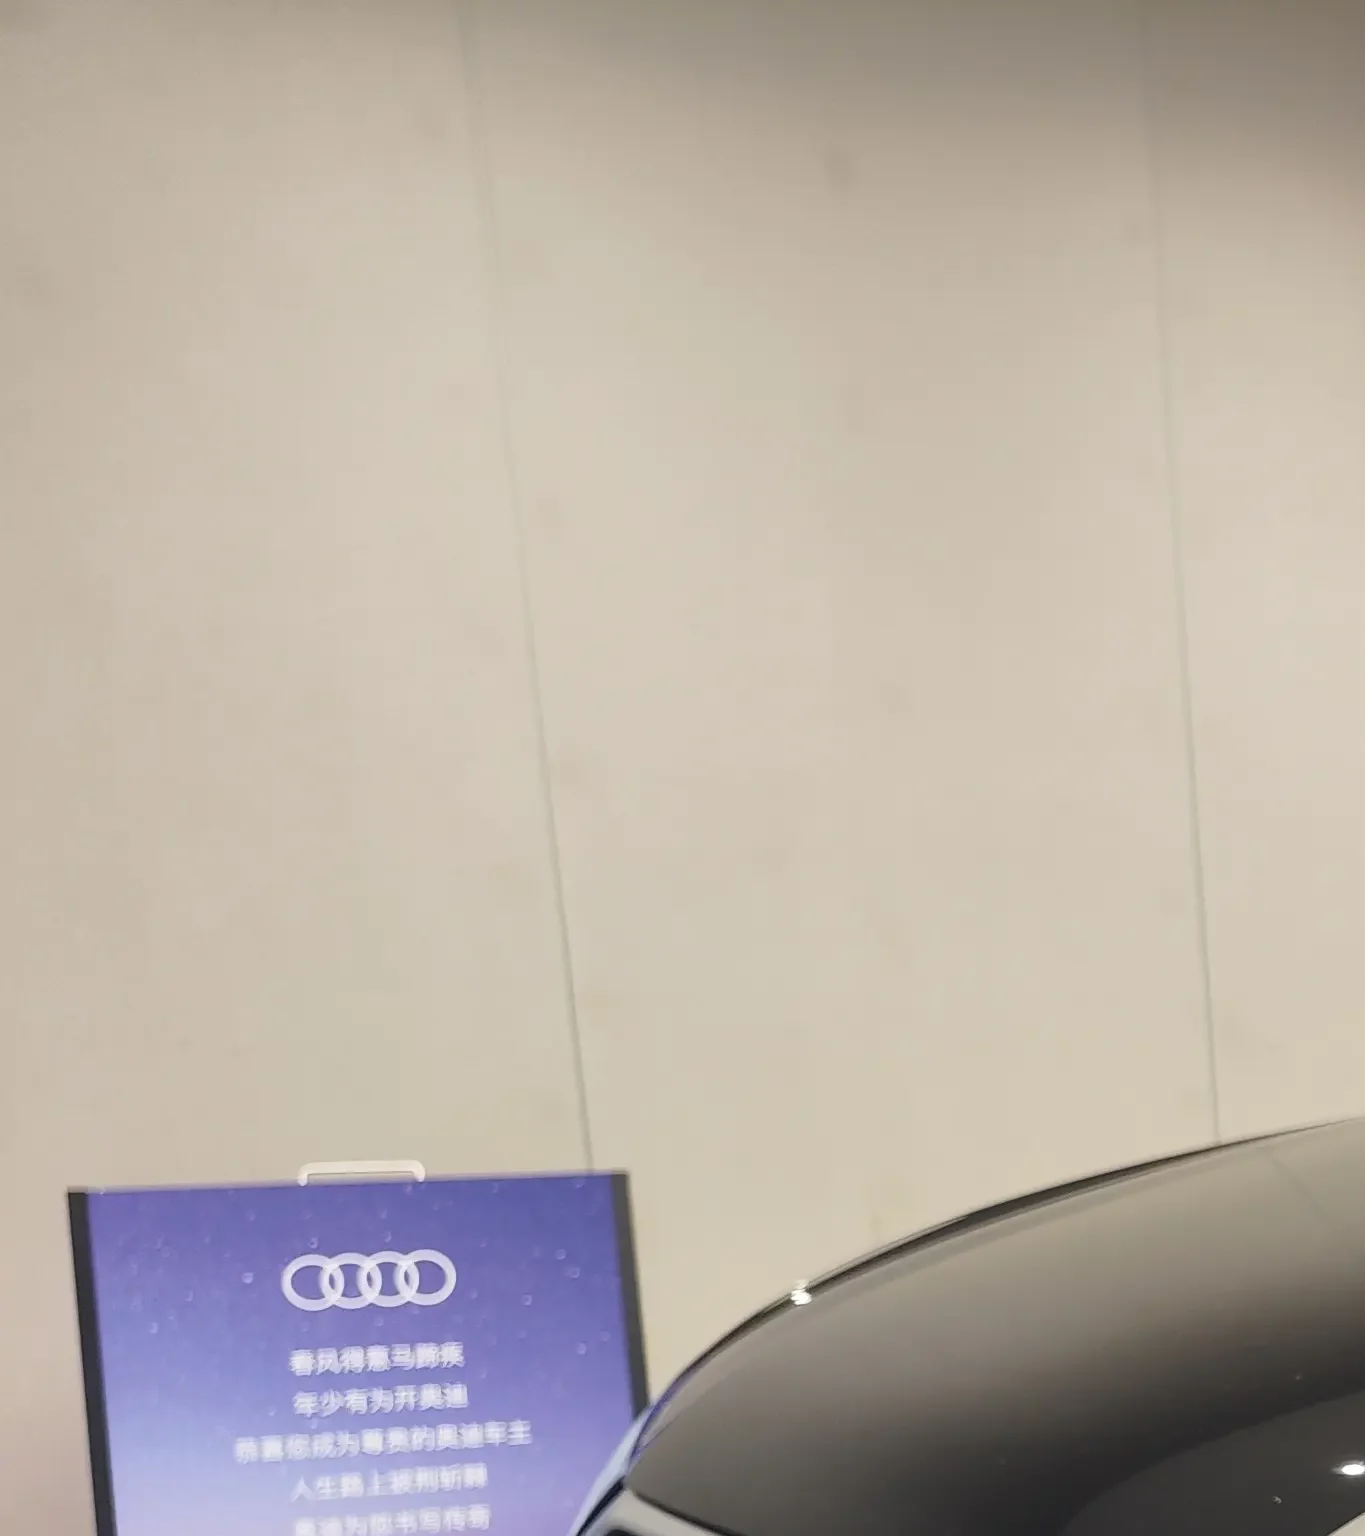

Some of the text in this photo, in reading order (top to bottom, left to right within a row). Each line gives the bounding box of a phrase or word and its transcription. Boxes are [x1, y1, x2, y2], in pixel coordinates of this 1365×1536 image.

[292, 1381, 469, 1417] 年少有为开奥迪
